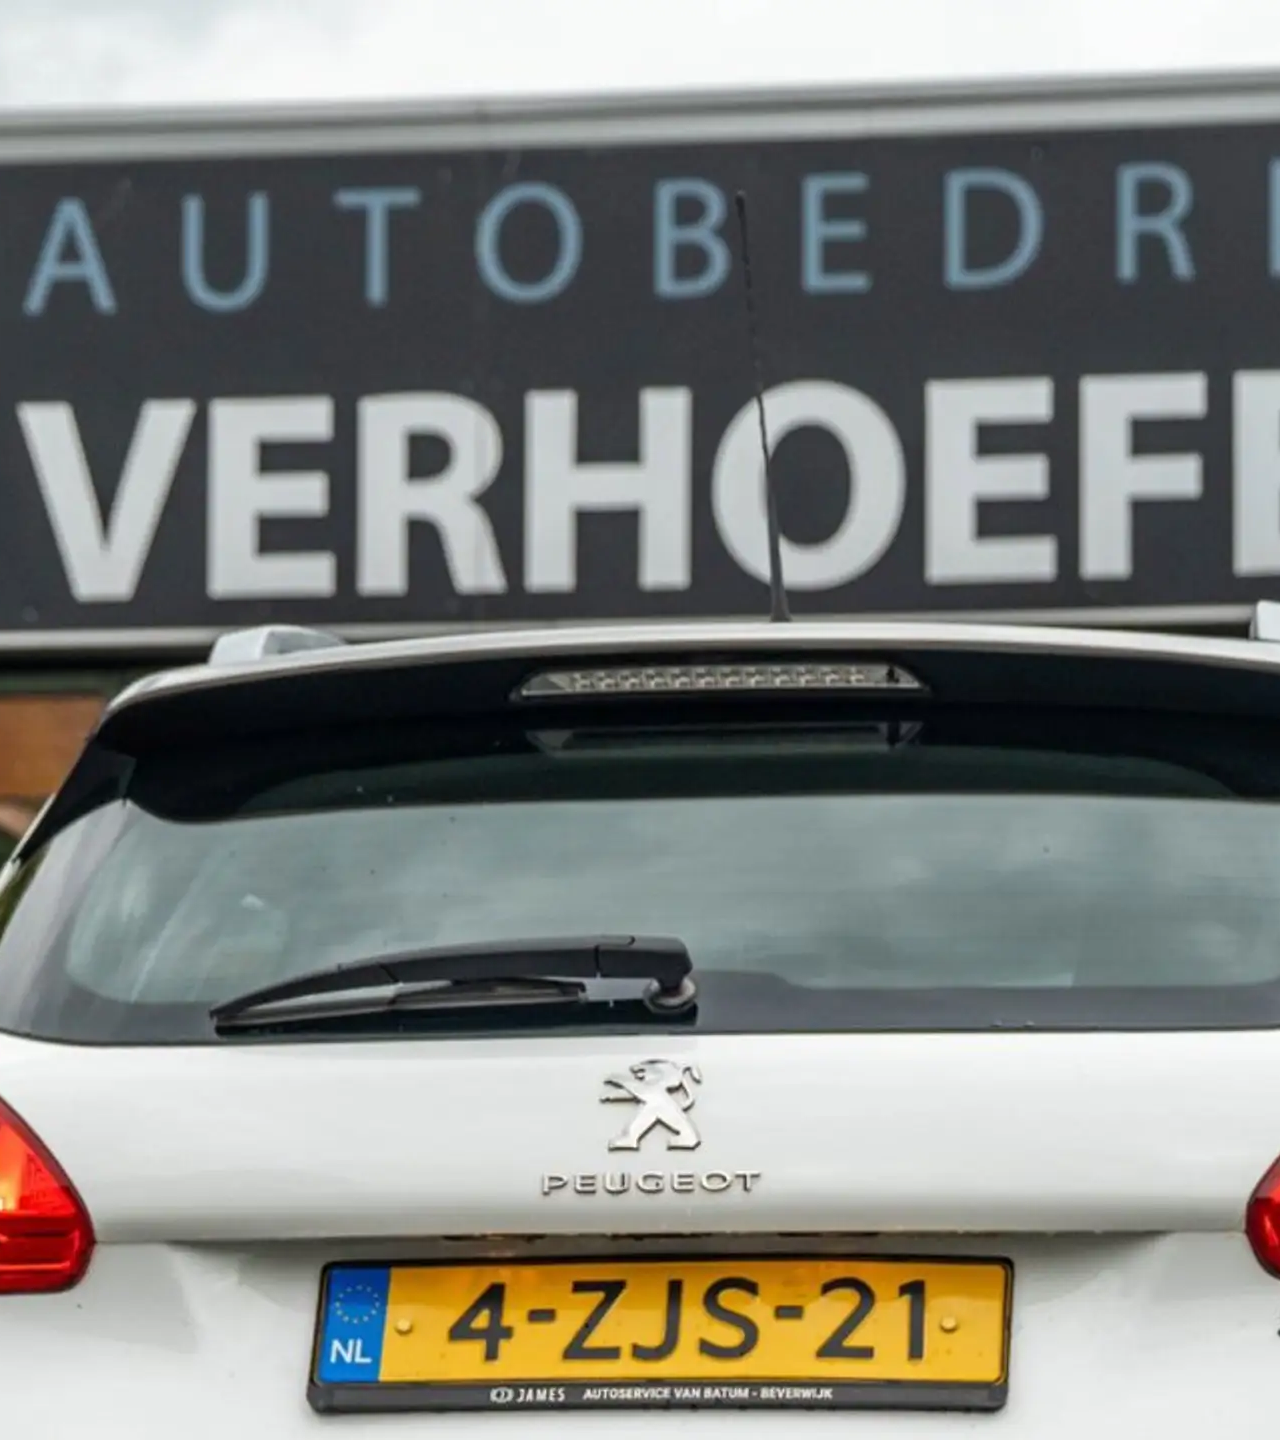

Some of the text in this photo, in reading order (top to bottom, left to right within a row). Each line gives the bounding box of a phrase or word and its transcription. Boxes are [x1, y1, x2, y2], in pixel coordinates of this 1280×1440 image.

[539, 1170, 762, 1195] PEUGEOT
[447, 1276, 929, 1363] 4-ZJS-21
[329, 1337, 372, 1365] NL
[517, 1386, 566, 1403] JAMES
[582, 1386, 671, 1401] AUTOSERVICE
[674, 1386, 700, 1400] VAN
[703, 1386, 749, 1400] BATUM
[760, 1386, 833, 1400] BEVERWIJK
